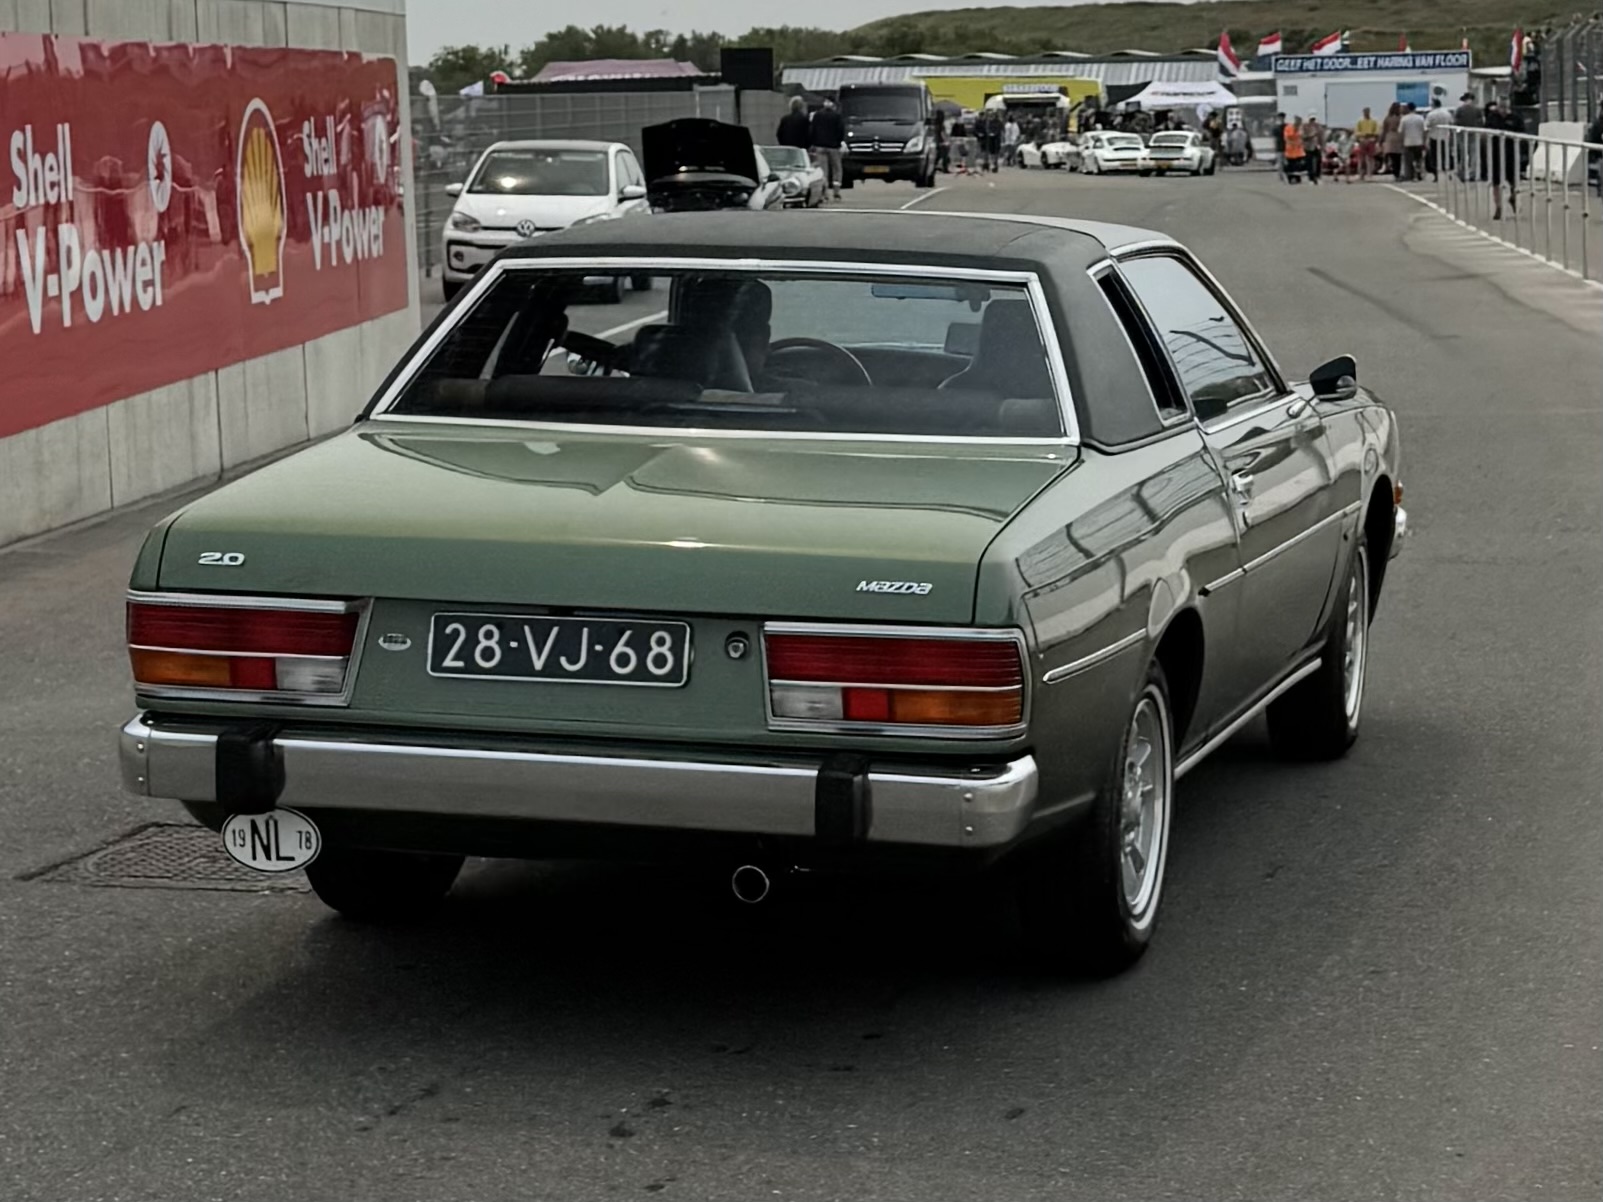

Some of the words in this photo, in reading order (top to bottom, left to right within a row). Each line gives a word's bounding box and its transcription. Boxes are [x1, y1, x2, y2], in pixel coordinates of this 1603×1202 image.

[1414, 54, 1434, 67] VAN
[1435, 53, 1468, 66] FLOOR
[10, 122, 73, 209] Shell
[302, 115, 337, 178] Shell
[306, 188, 385, 270] V-Power
[16, 222, 165, 334] V-Power
[441, 622, 675, 676] 28-VJ-68
[232, 828, 246, 848] 19
[250, 818, 295, 861] NL
[296, 830, 312, 850] 78
